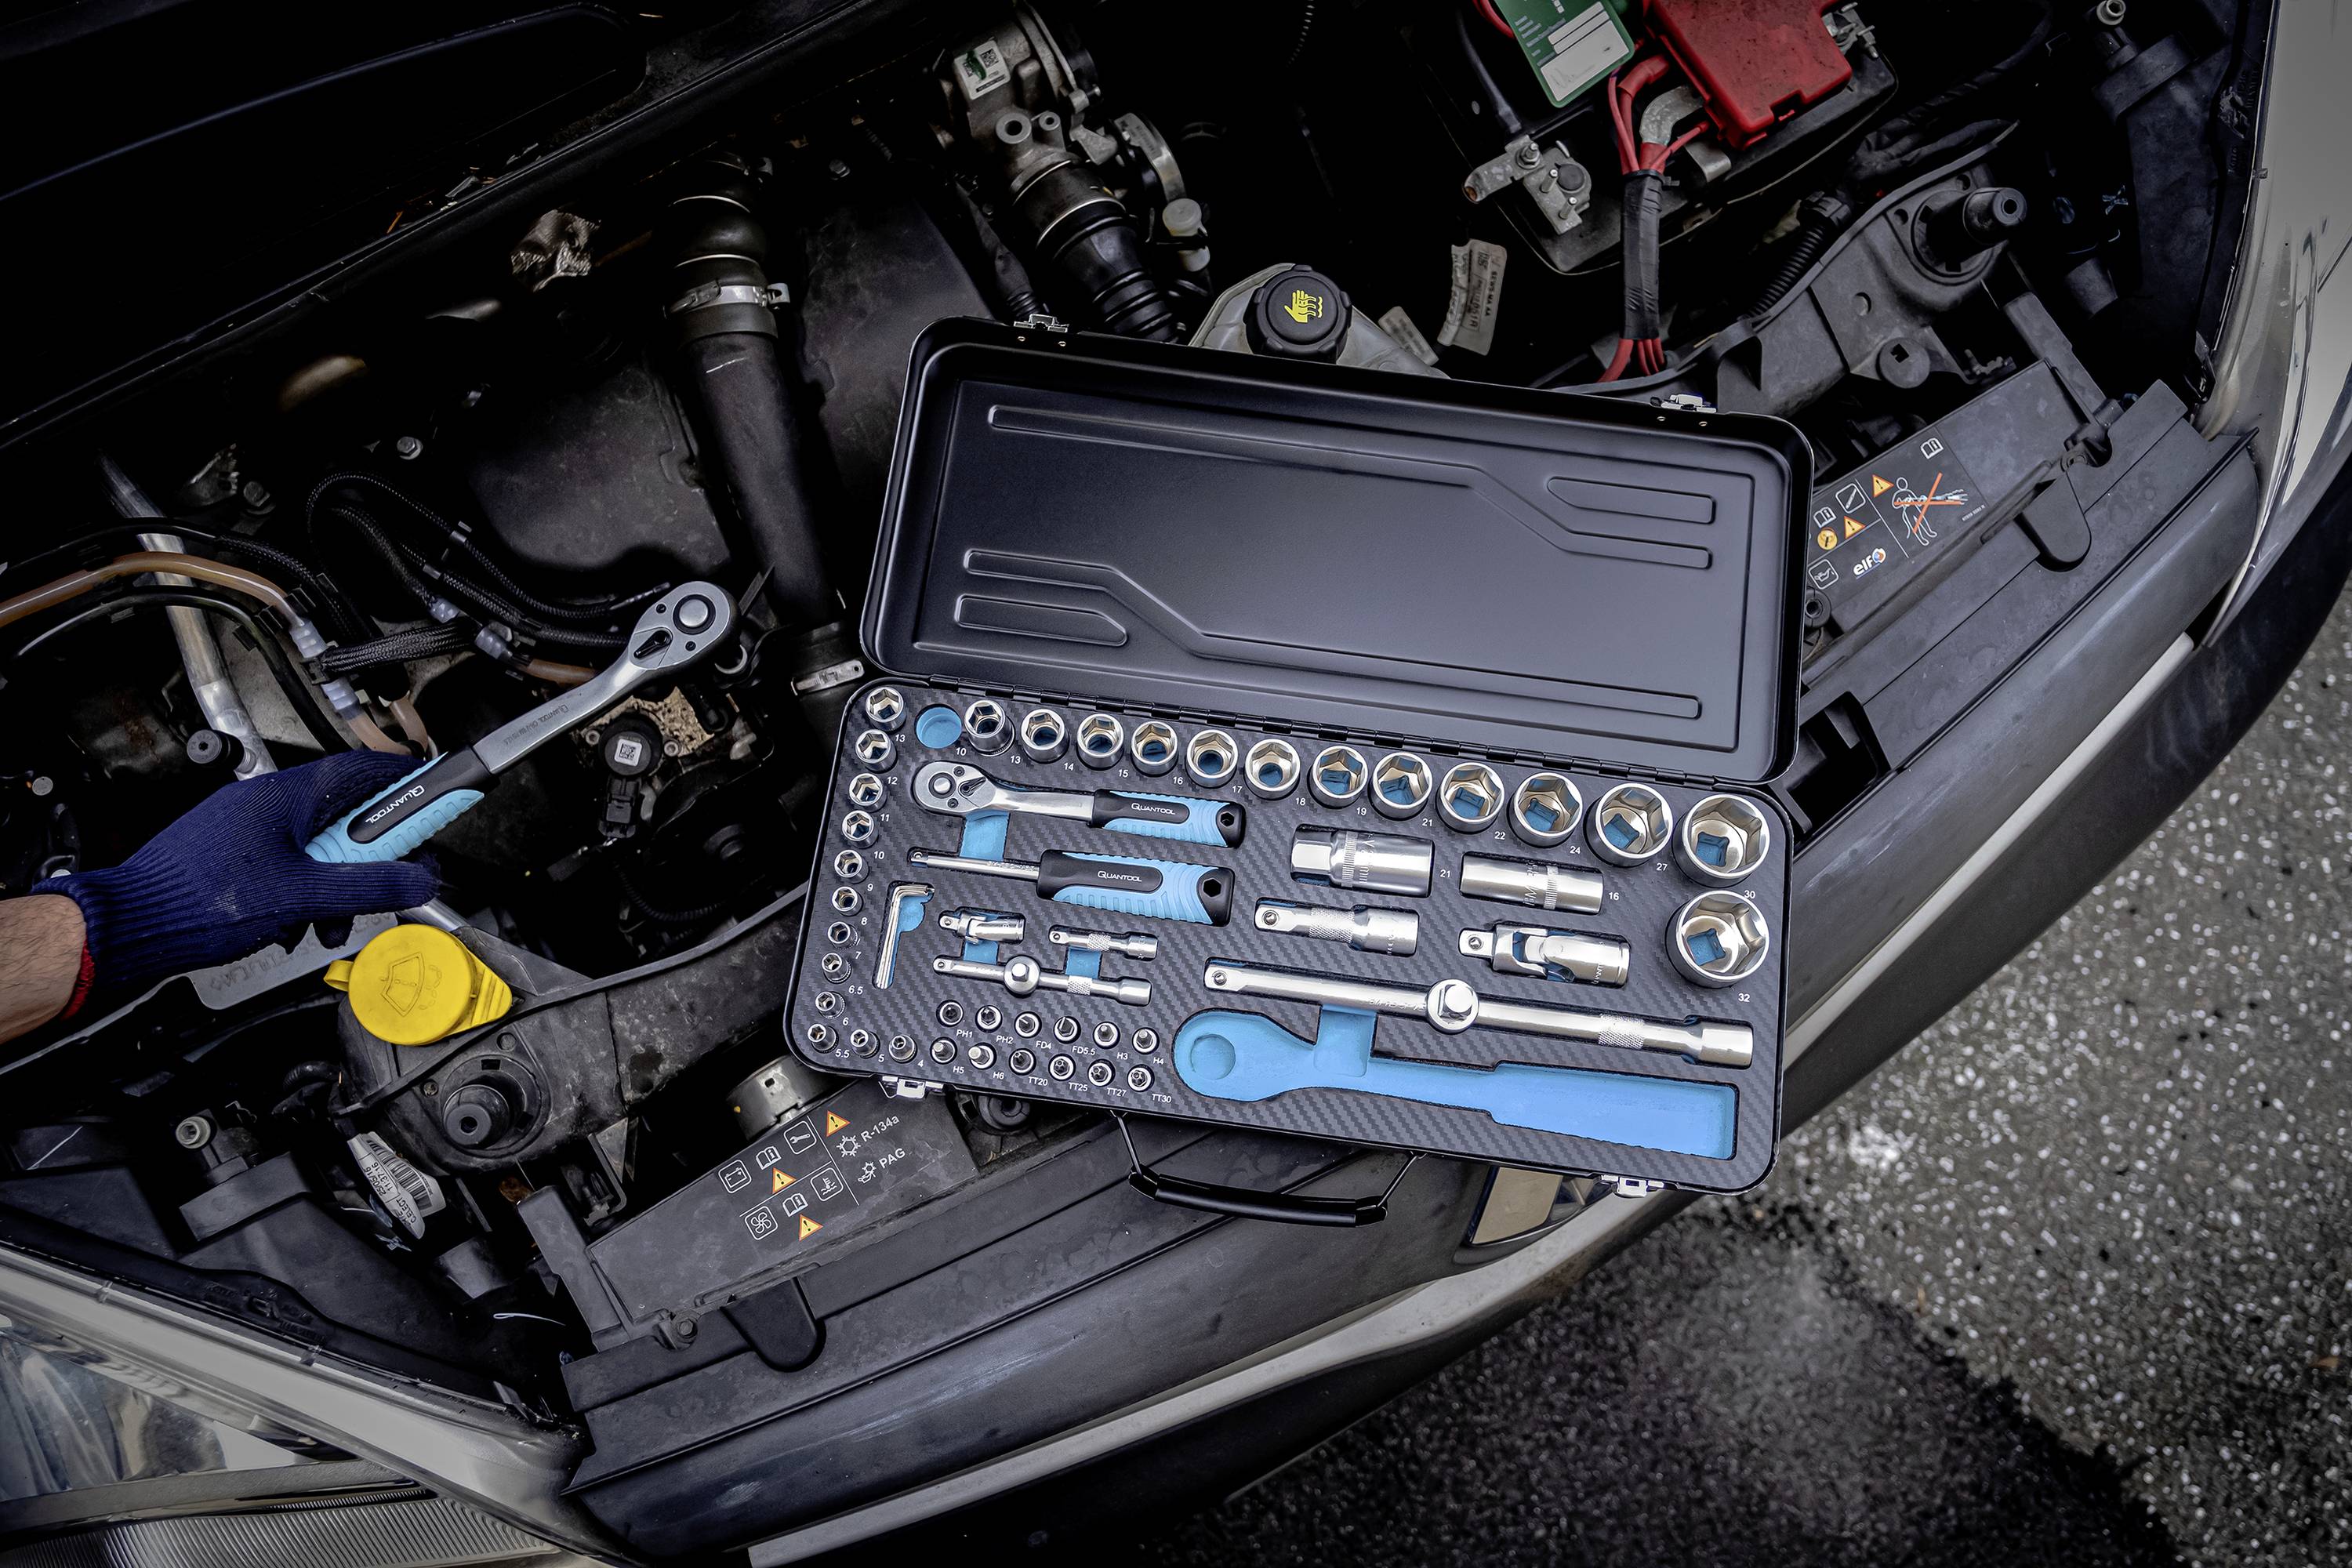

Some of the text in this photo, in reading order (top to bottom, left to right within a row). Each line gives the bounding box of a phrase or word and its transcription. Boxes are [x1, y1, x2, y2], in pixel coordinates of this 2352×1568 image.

[1853, 555, 1873, 575] elf
[895, 734, 906, 742] 13
[956, 747, 967, 757] 10
[1010, 755, 1021, 764] 13
[1064, 762, 1074, 771] 14
[1118, 769, 1129, 778] 15
[887, 776, 898, 785] 12
[1173, 776, 1184, 785] 16
[1232, 785, 1243, 793] 17
[365, 784, 425, 824] QUANTOOL
[1295, 797, 1306, 806] 18
[1131, 802, 1176, 815] QUANTOOL
[1356, 807, 1367, 816] 19
[880, 813, 890, 822] 11
[1421, 818, 1432, 827] 21
[1494, 831, 1506, 840] 22
[1570, 845, 1581, 855] 24
[873, 851, 885, 860] 10
[1656, 862, 1668, 871] 27
[1097, 870, 1142, 882] QUANTOOL
[1439, 869, 1450, 878] 21
[867, 883, 874, 891] 9
[1608, 891, 1620, 901] 16
[1743, 890, 1756, 899] 30
[861, 916, 868, 926] 8
[855, 951, 862, 960] 7
[848, 985, 863, 995] 6.5
[1738, 993, 1751, 1003] 32
[842, 1017, 849, 1026] 6
[956, 1029, 973, 1038] PH1
[996, 1035, 1014, 1044] PH2
[1035, 1040, 1052, 1050] FD4
[835, 1048, 850, 1058] 5.5
[1072, 1045, 1096, 1056] FD5.5
[878, 1054, 884, 1062] 5
[1116, 1051, 1128, 1060] H3
[917, 1059, 924, 1068] 4
[953, 1065, 964, 1074] H5
[993, 1071, 1005, 1080] H6
[1028, 1076, 1048, 1087] TT20
[1068, 1082, 1088, 1092] TT25
[1106, 1087, 1127, 1097] TT27
[1152, 1093, 1172, 1103] TT30
[860, 1116, 900, 1142] R-134a
[878, 1148, 906, 1169] PAG
[371, 1162, 394, 1191] 11:37:16
[364, 1167, 387, 1196] 25/05/16
